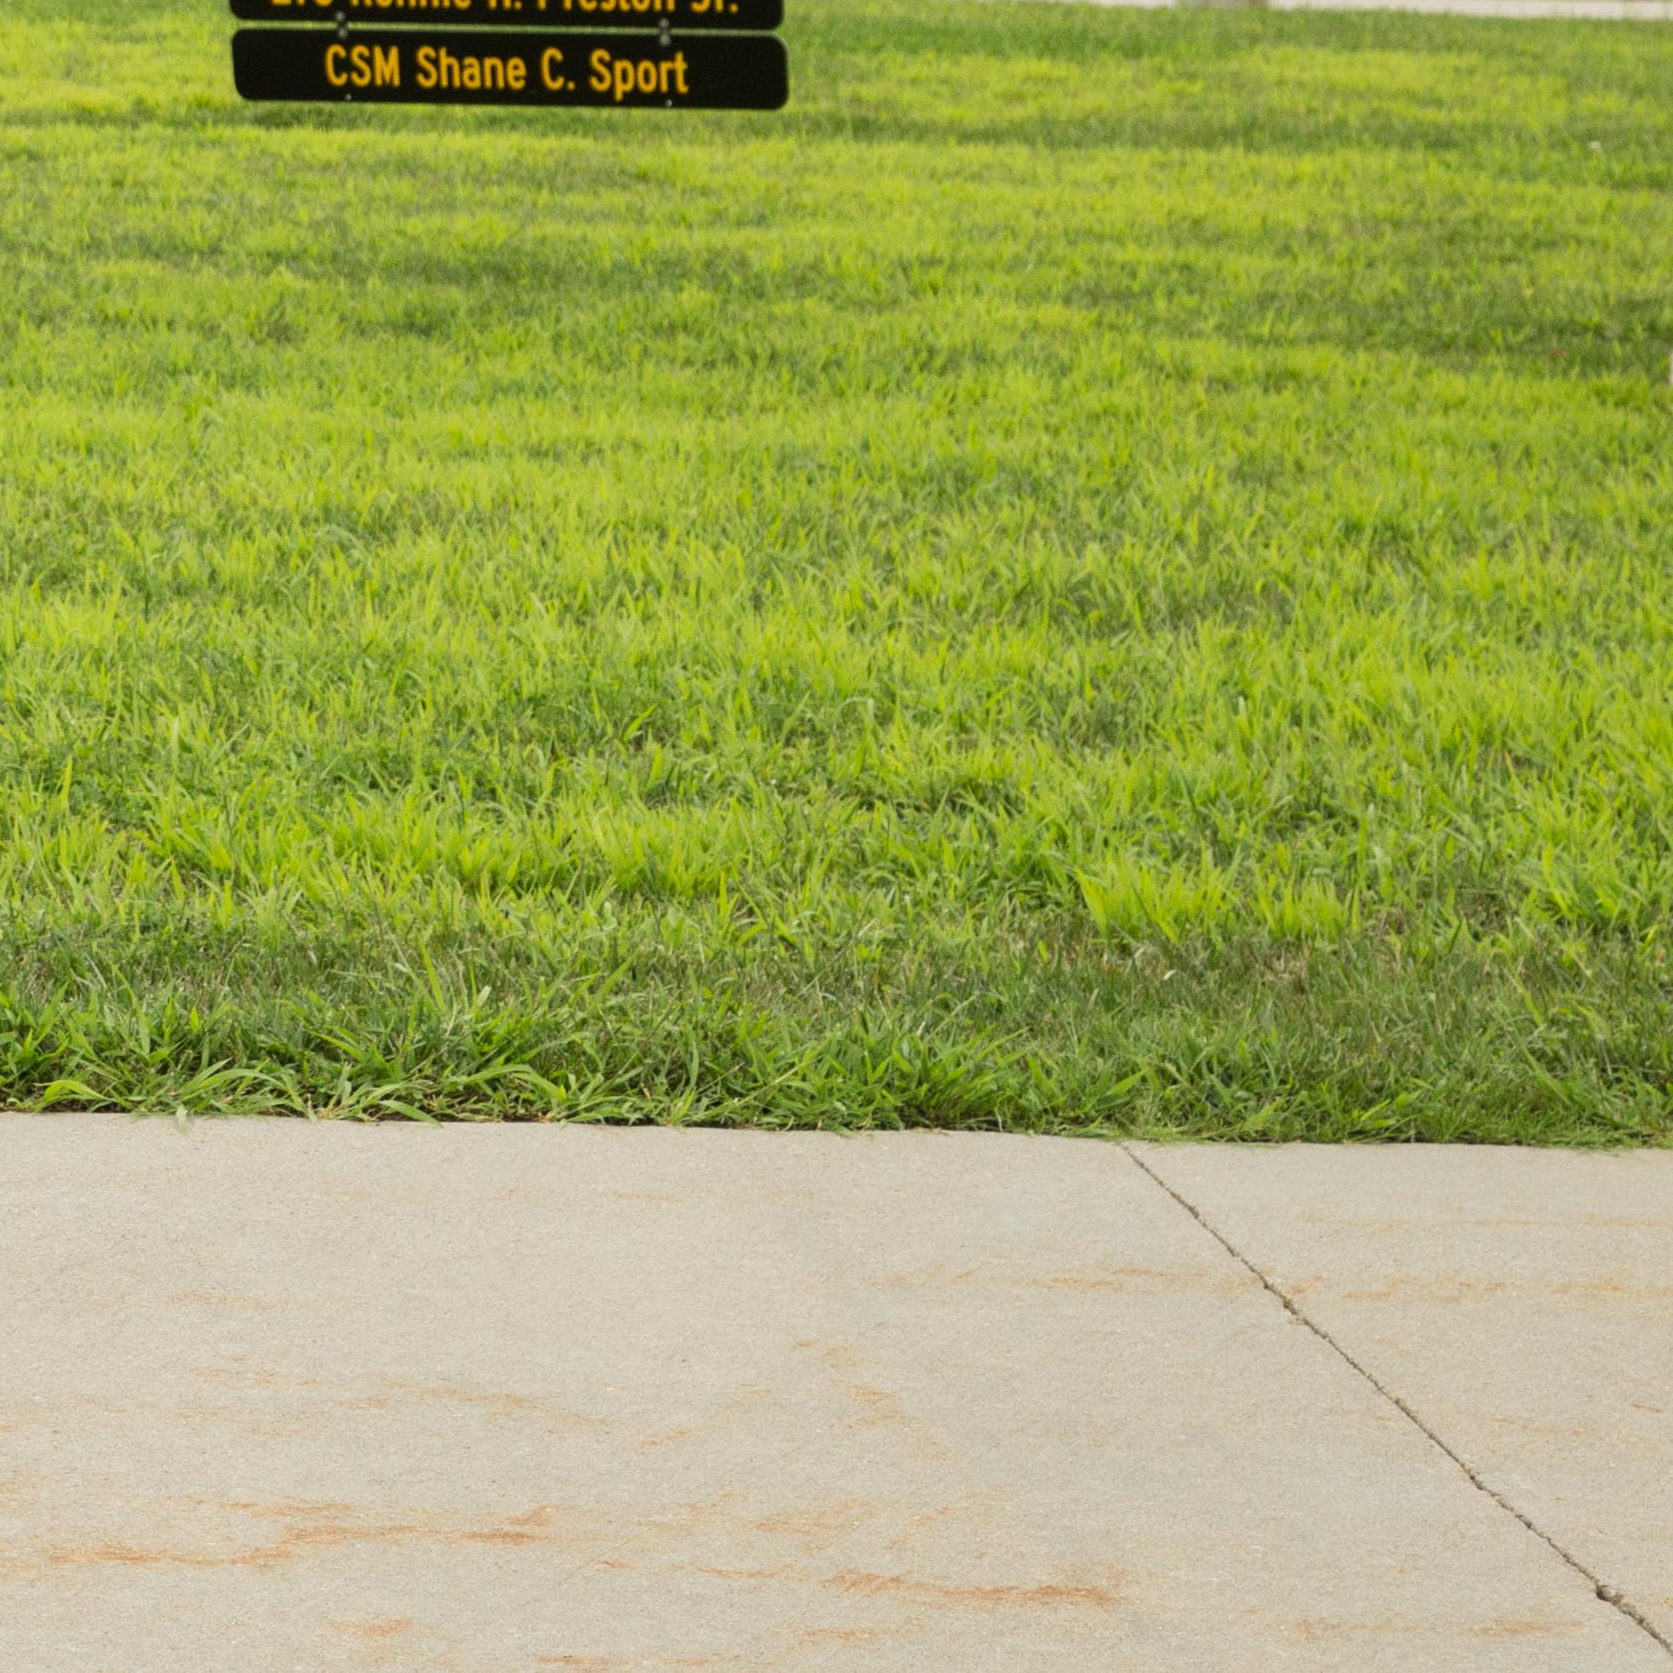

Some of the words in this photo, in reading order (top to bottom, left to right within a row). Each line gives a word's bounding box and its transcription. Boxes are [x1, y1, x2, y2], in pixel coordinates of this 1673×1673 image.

[325, 44, 400, 87] CSM
[416, 45, 527, 90] Shane
[541, 47, 575, 90] C.
[589, 48, 689, 101] Sport
